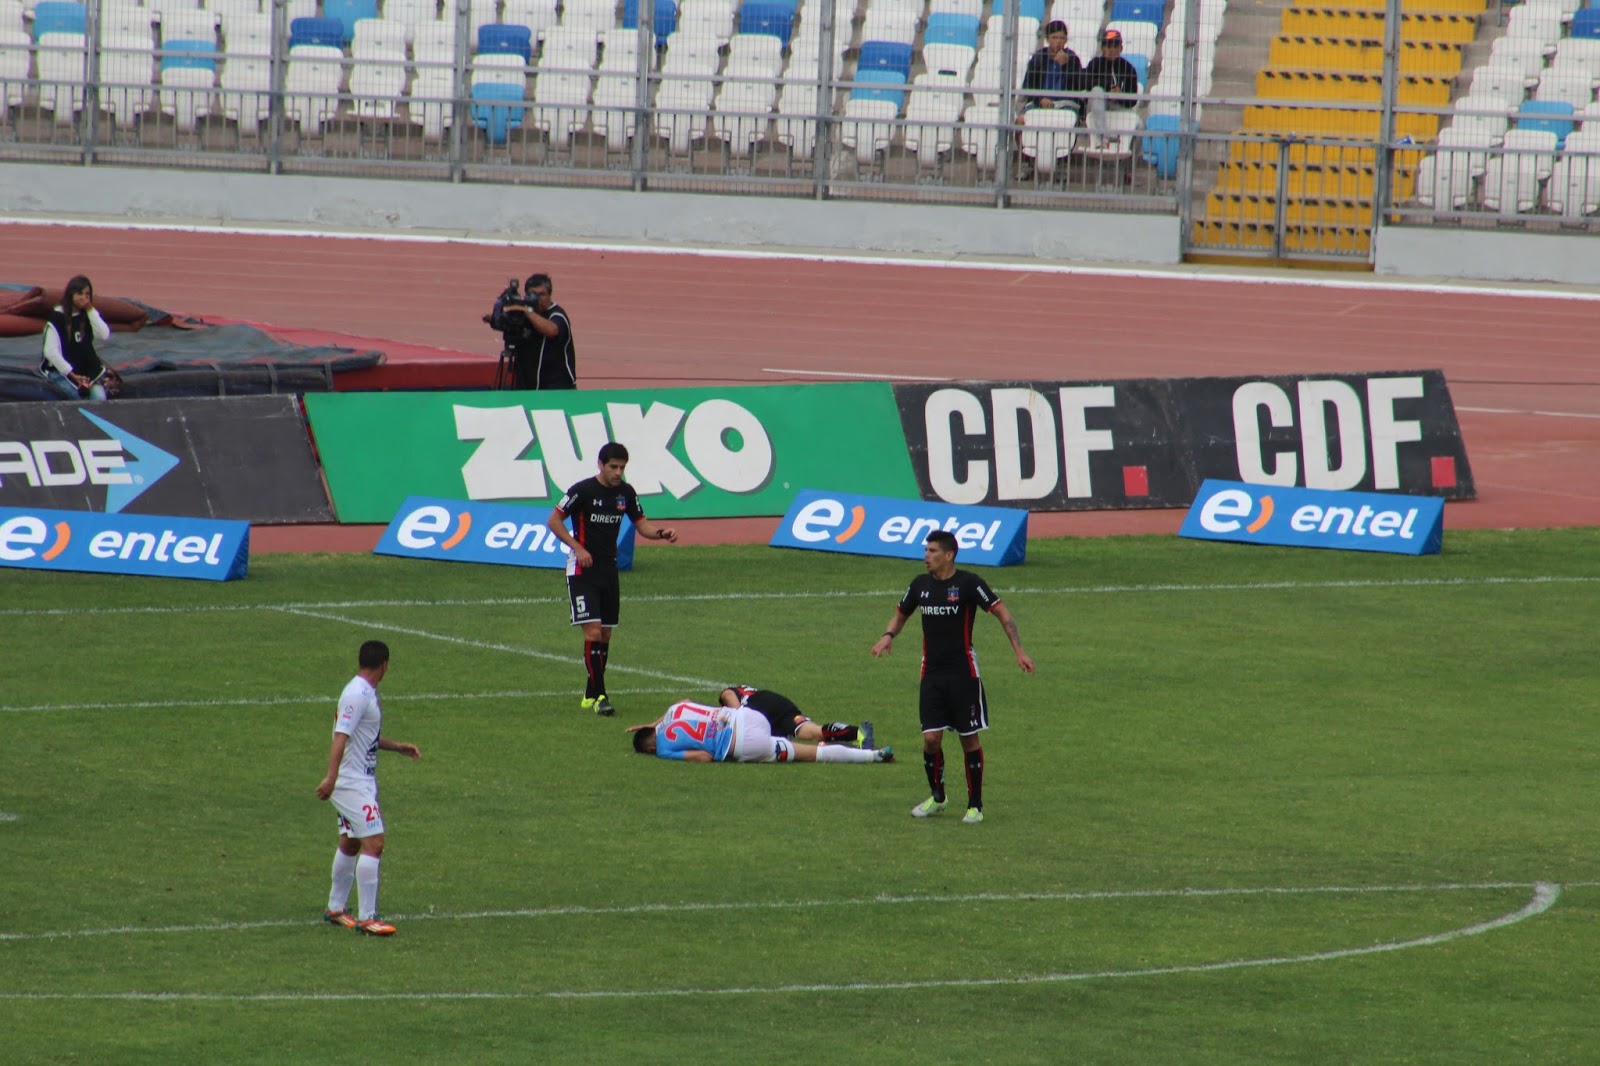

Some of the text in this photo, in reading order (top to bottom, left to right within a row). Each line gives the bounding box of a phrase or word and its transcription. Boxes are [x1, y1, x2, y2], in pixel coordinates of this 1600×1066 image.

[453, 399, 773, 499] ZUKO
[1291, 507, 1419, 540] entel
[89, 529, 223, 565] entel
[576, 595, 586, 613] 5
[665, 704, 711, 742] 27
